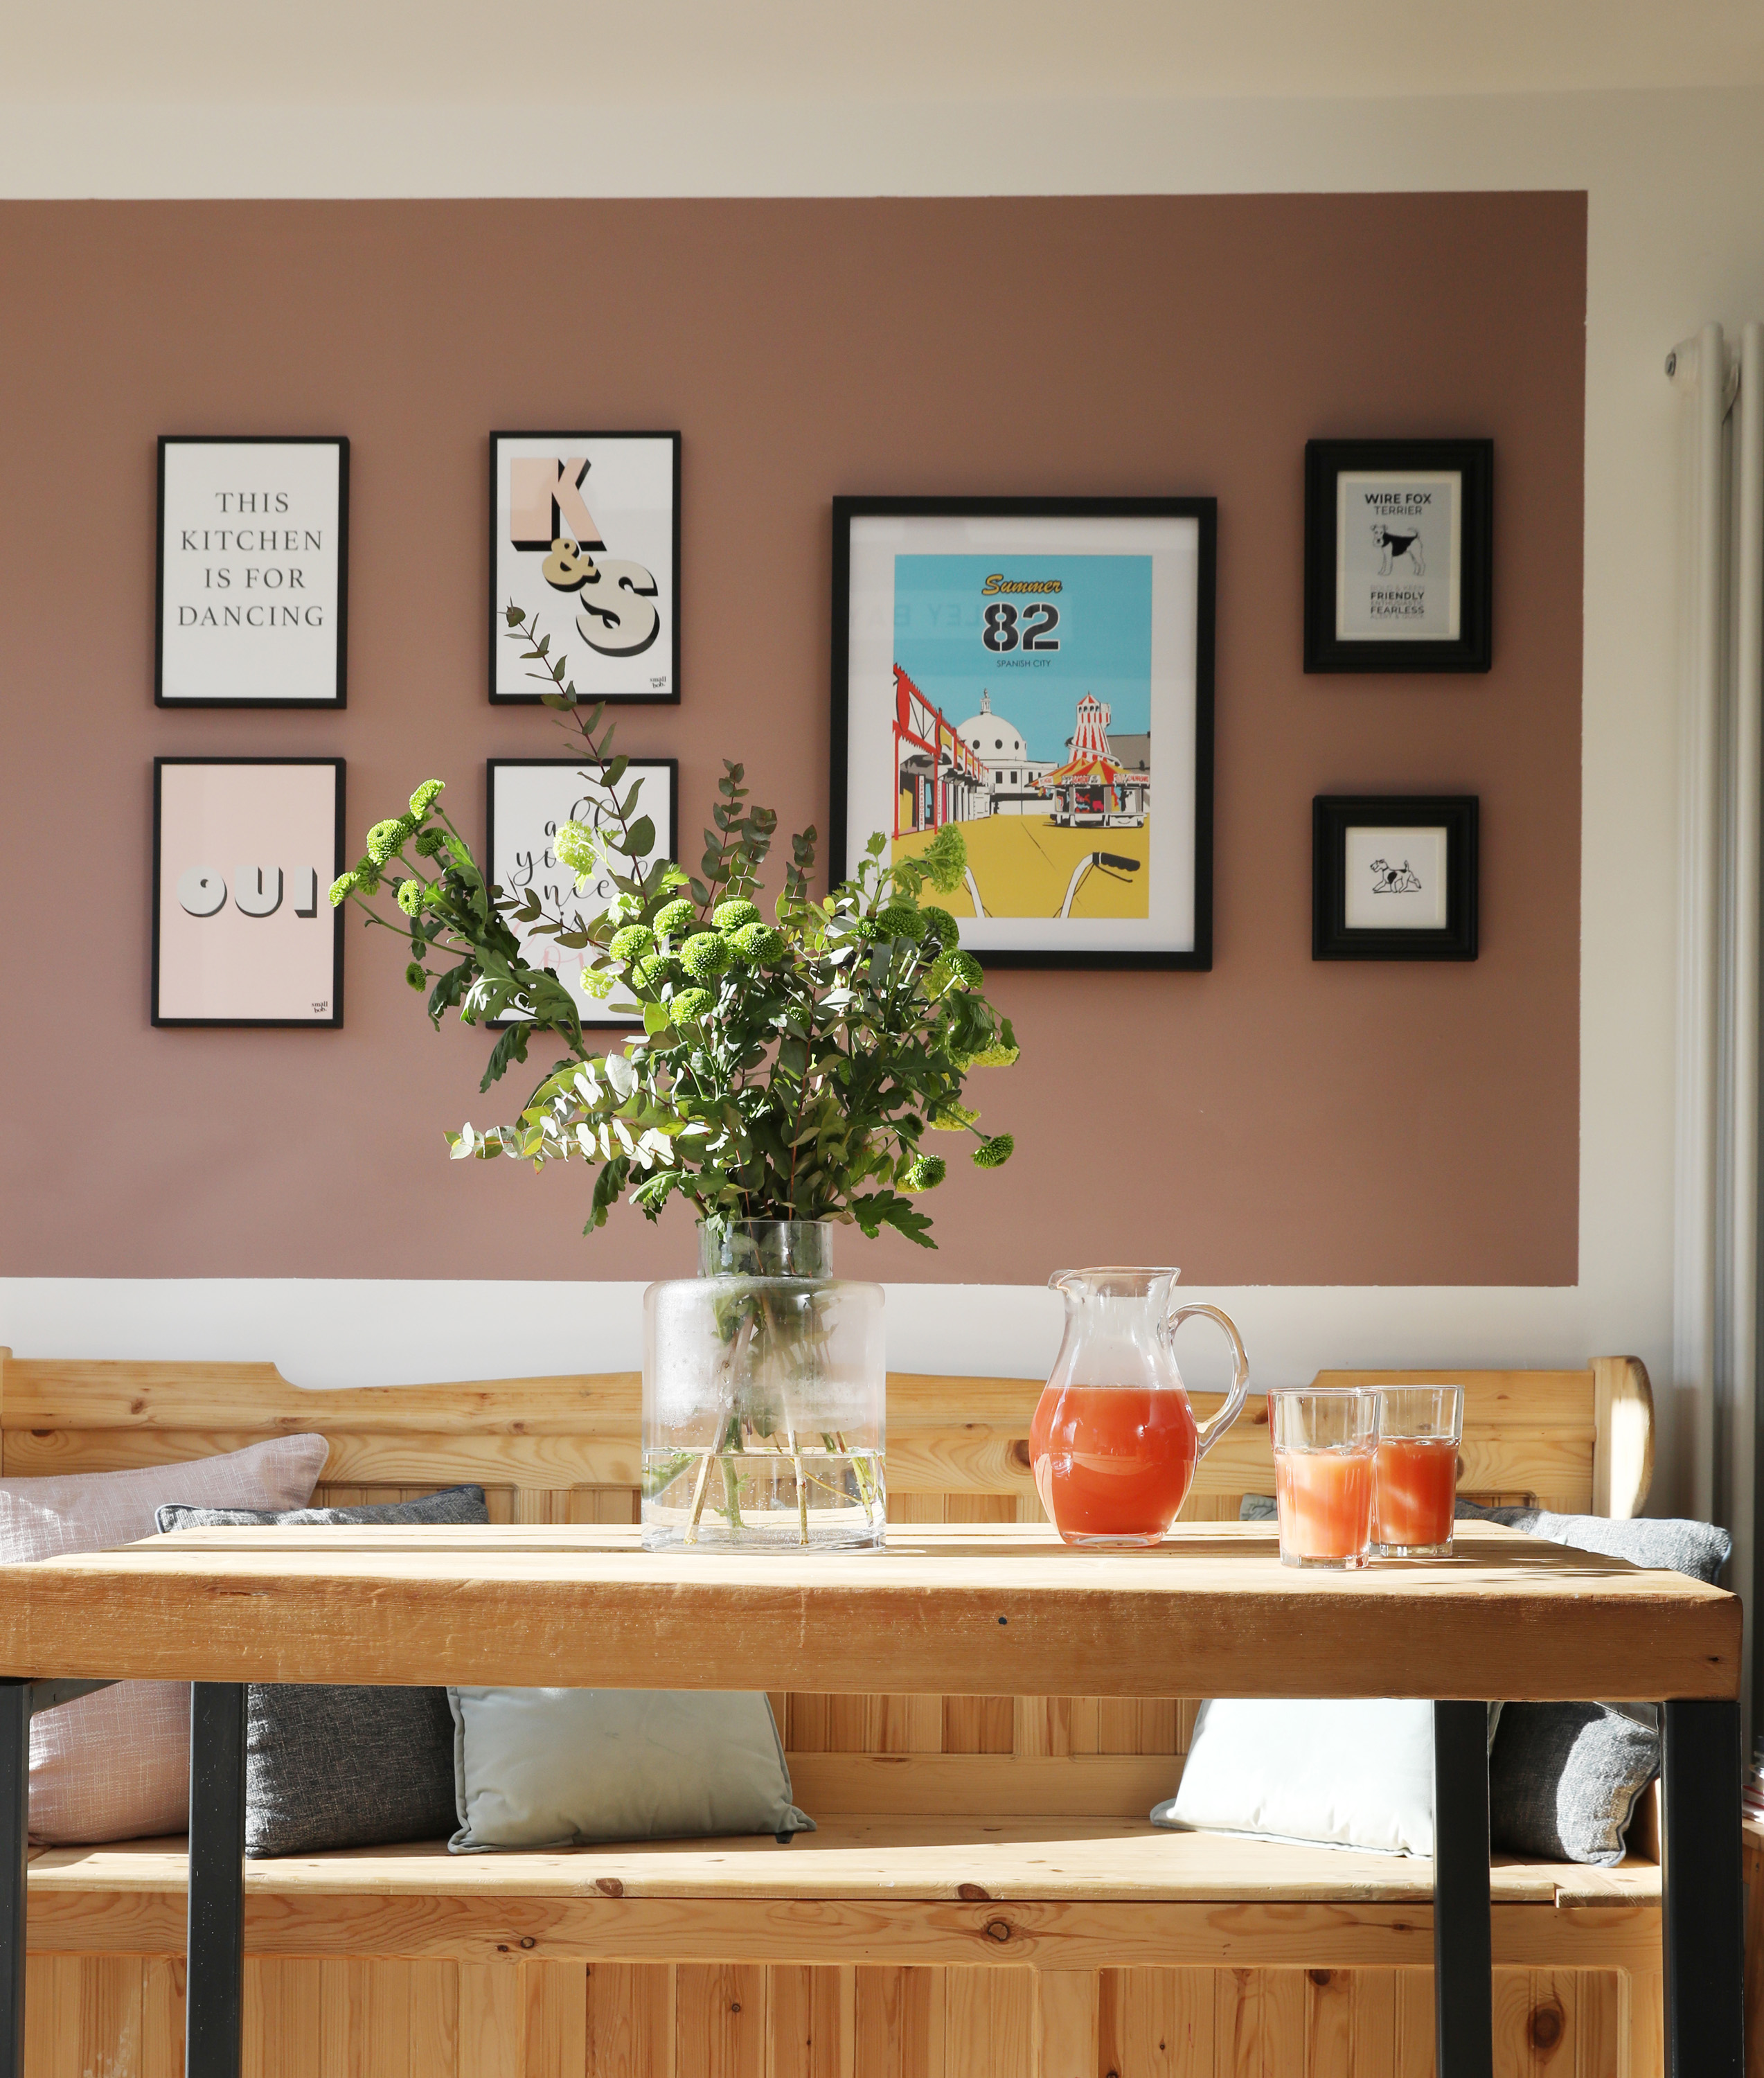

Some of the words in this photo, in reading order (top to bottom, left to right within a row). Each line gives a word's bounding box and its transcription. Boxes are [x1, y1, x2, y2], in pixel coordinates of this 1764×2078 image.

[215, 492, 289, 513] THIS
[510, 457, 607, 551] K
[1364, 493, 1400, 504] WIRE
[1406, 493, 1432, 504] FOX
[1374, 506, 1423, 515] TERRIER
[181, 530, 322, 551] KITCHEN
[542, 538, 601, 592] &
[204, 567, 231, 589] IS
[245, 567, 305, 589] FOR
[981, 574, 1062, 596] Summer
[1371, 592, 1425, 600] FRIENDLY
[178, 605, 323, 626] DANCING
[576, 559, 660, 657] S
[1371, 606, 1425, 614] FEARLESS
[982, 602, 1060, 653] 82
[177, 866, 318, 918] OUI
